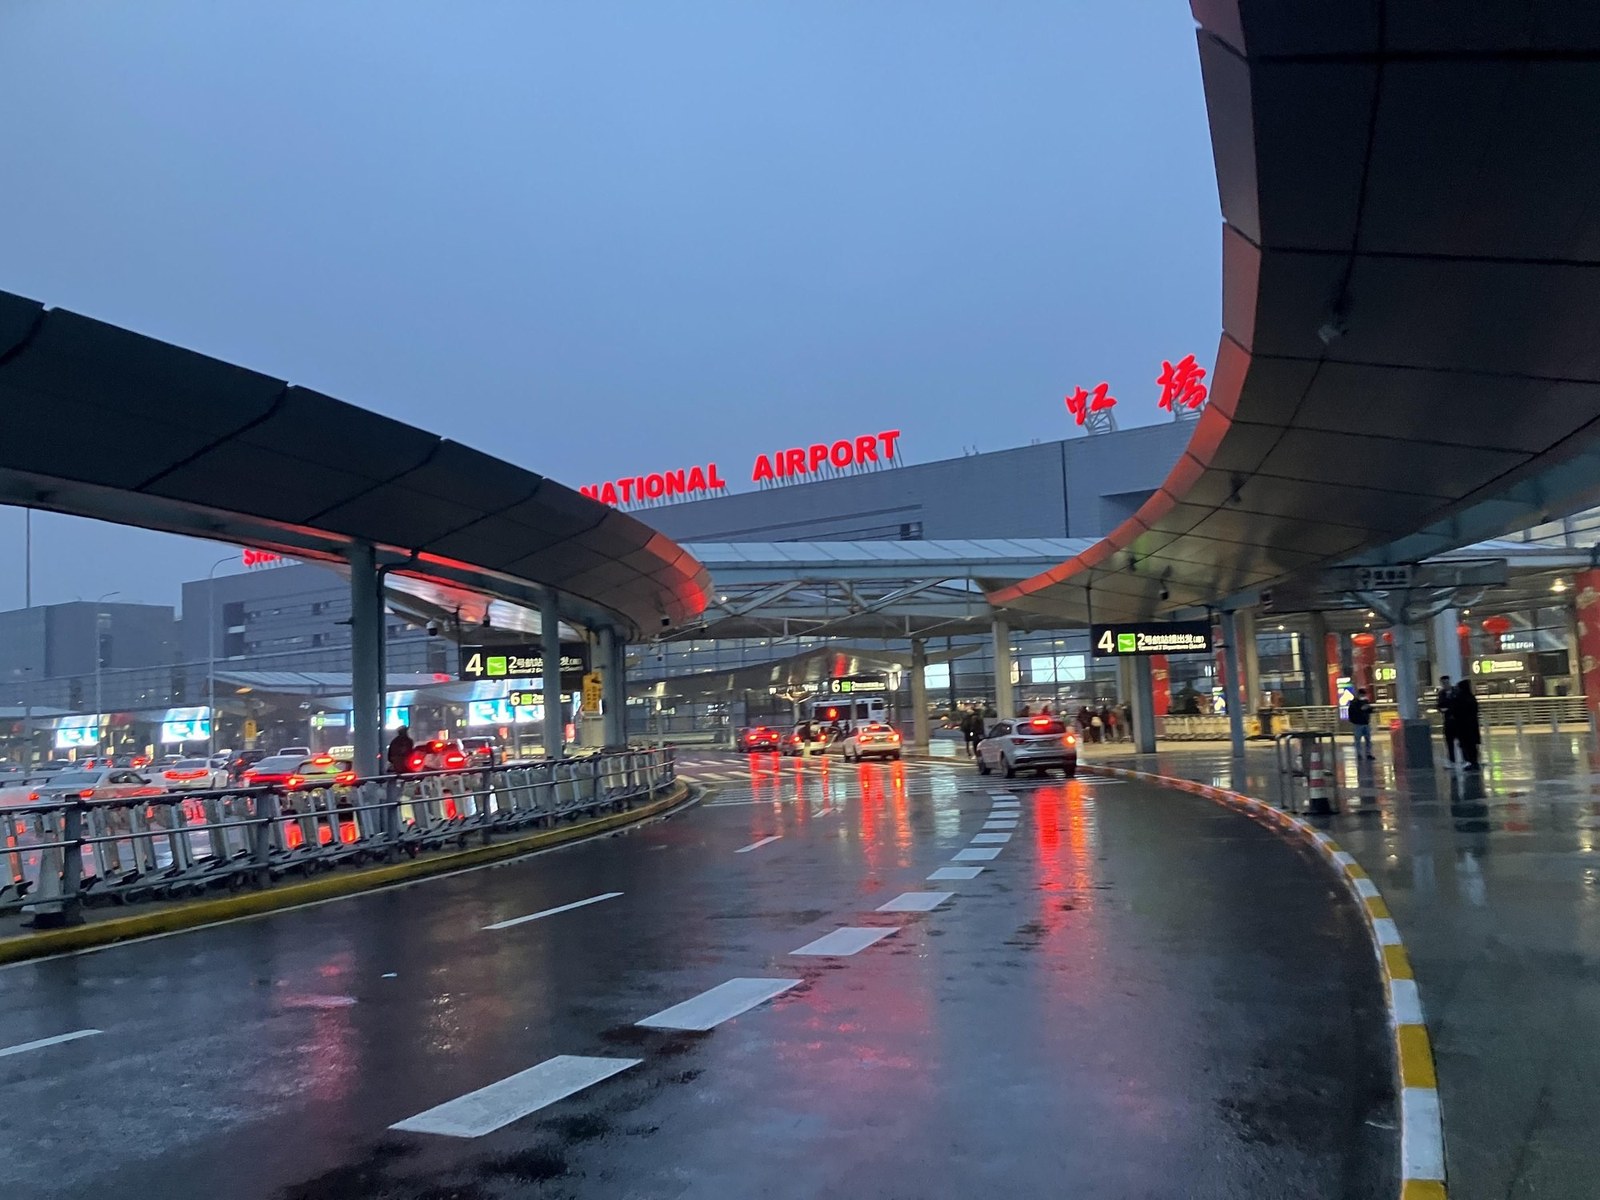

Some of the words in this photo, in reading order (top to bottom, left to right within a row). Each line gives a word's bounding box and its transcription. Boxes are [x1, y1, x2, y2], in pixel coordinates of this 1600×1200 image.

[752, 429, 901, 481] AIRPORT
[1097, 630, 1115, 653] 4
[465, 653, 484, 676] 4
[1472, 660, 1480, 674] 6
[1375, 668, 1382, 681] 6
[832, 680, 841, 693] 6
[510, 692, 520, 706] 6
